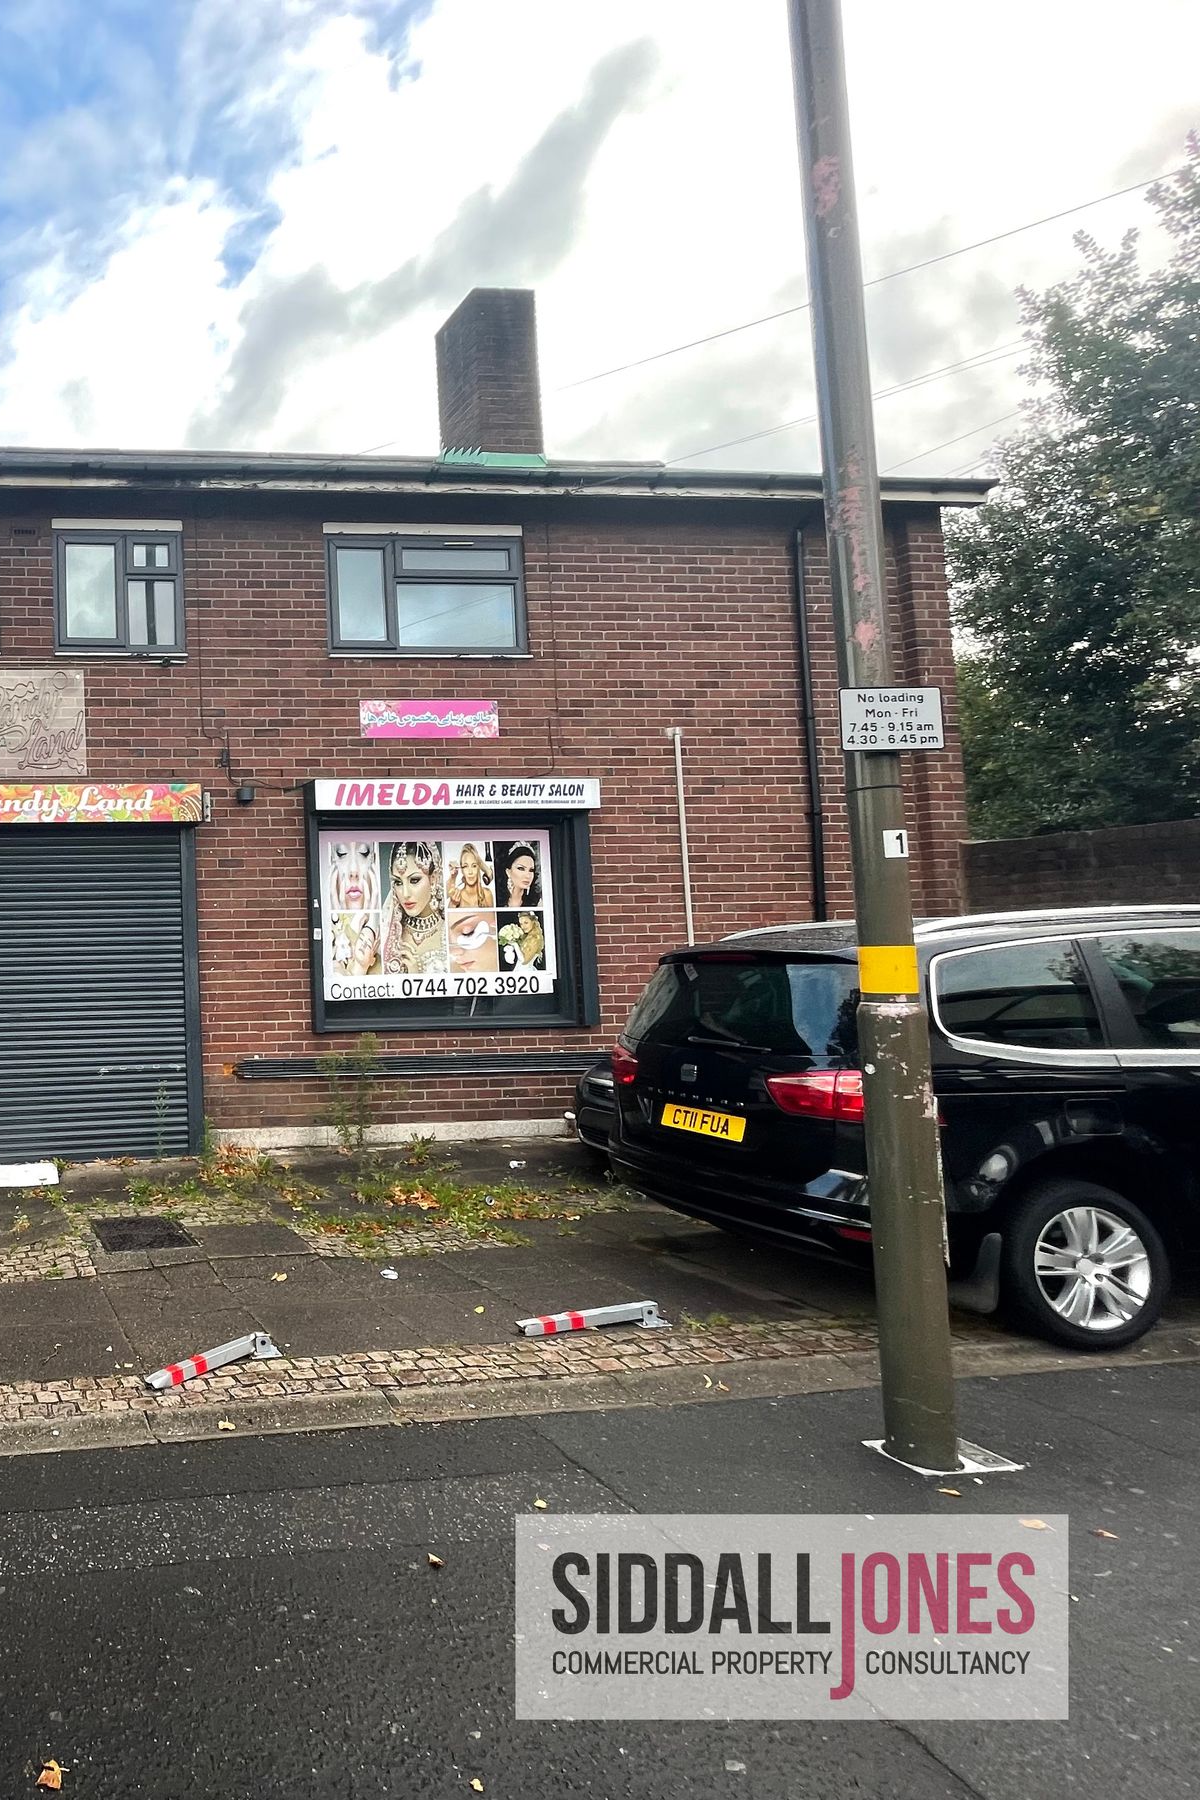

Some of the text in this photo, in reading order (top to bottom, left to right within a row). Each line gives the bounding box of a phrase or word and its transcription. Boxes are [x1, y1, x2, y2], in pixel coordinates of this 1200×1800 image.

[857, 692, 924, 704] No loading
[865, 708, 892, 718] Mon
[902, 708, 918, 718] Fri
[849, 722, 878, 732] 7.45
[887, 721, 914, 732] 9.15
[916, 723, 934, 731] am
[847, 734, 878, 745] 4.30
[888, 734, 917, 744] 6.45
[920, 735, 939, 745] pm
[77, 785, 155, 812] Land
[334, 783, 585, 806] IMELDA HAIR & BEAUTY SALON
[895, 832, 904, 854] 1
[330, 975, 540, 999] Contact: 0744 702 3920
[672, 1108, 729, 1136] CT11 FUA
